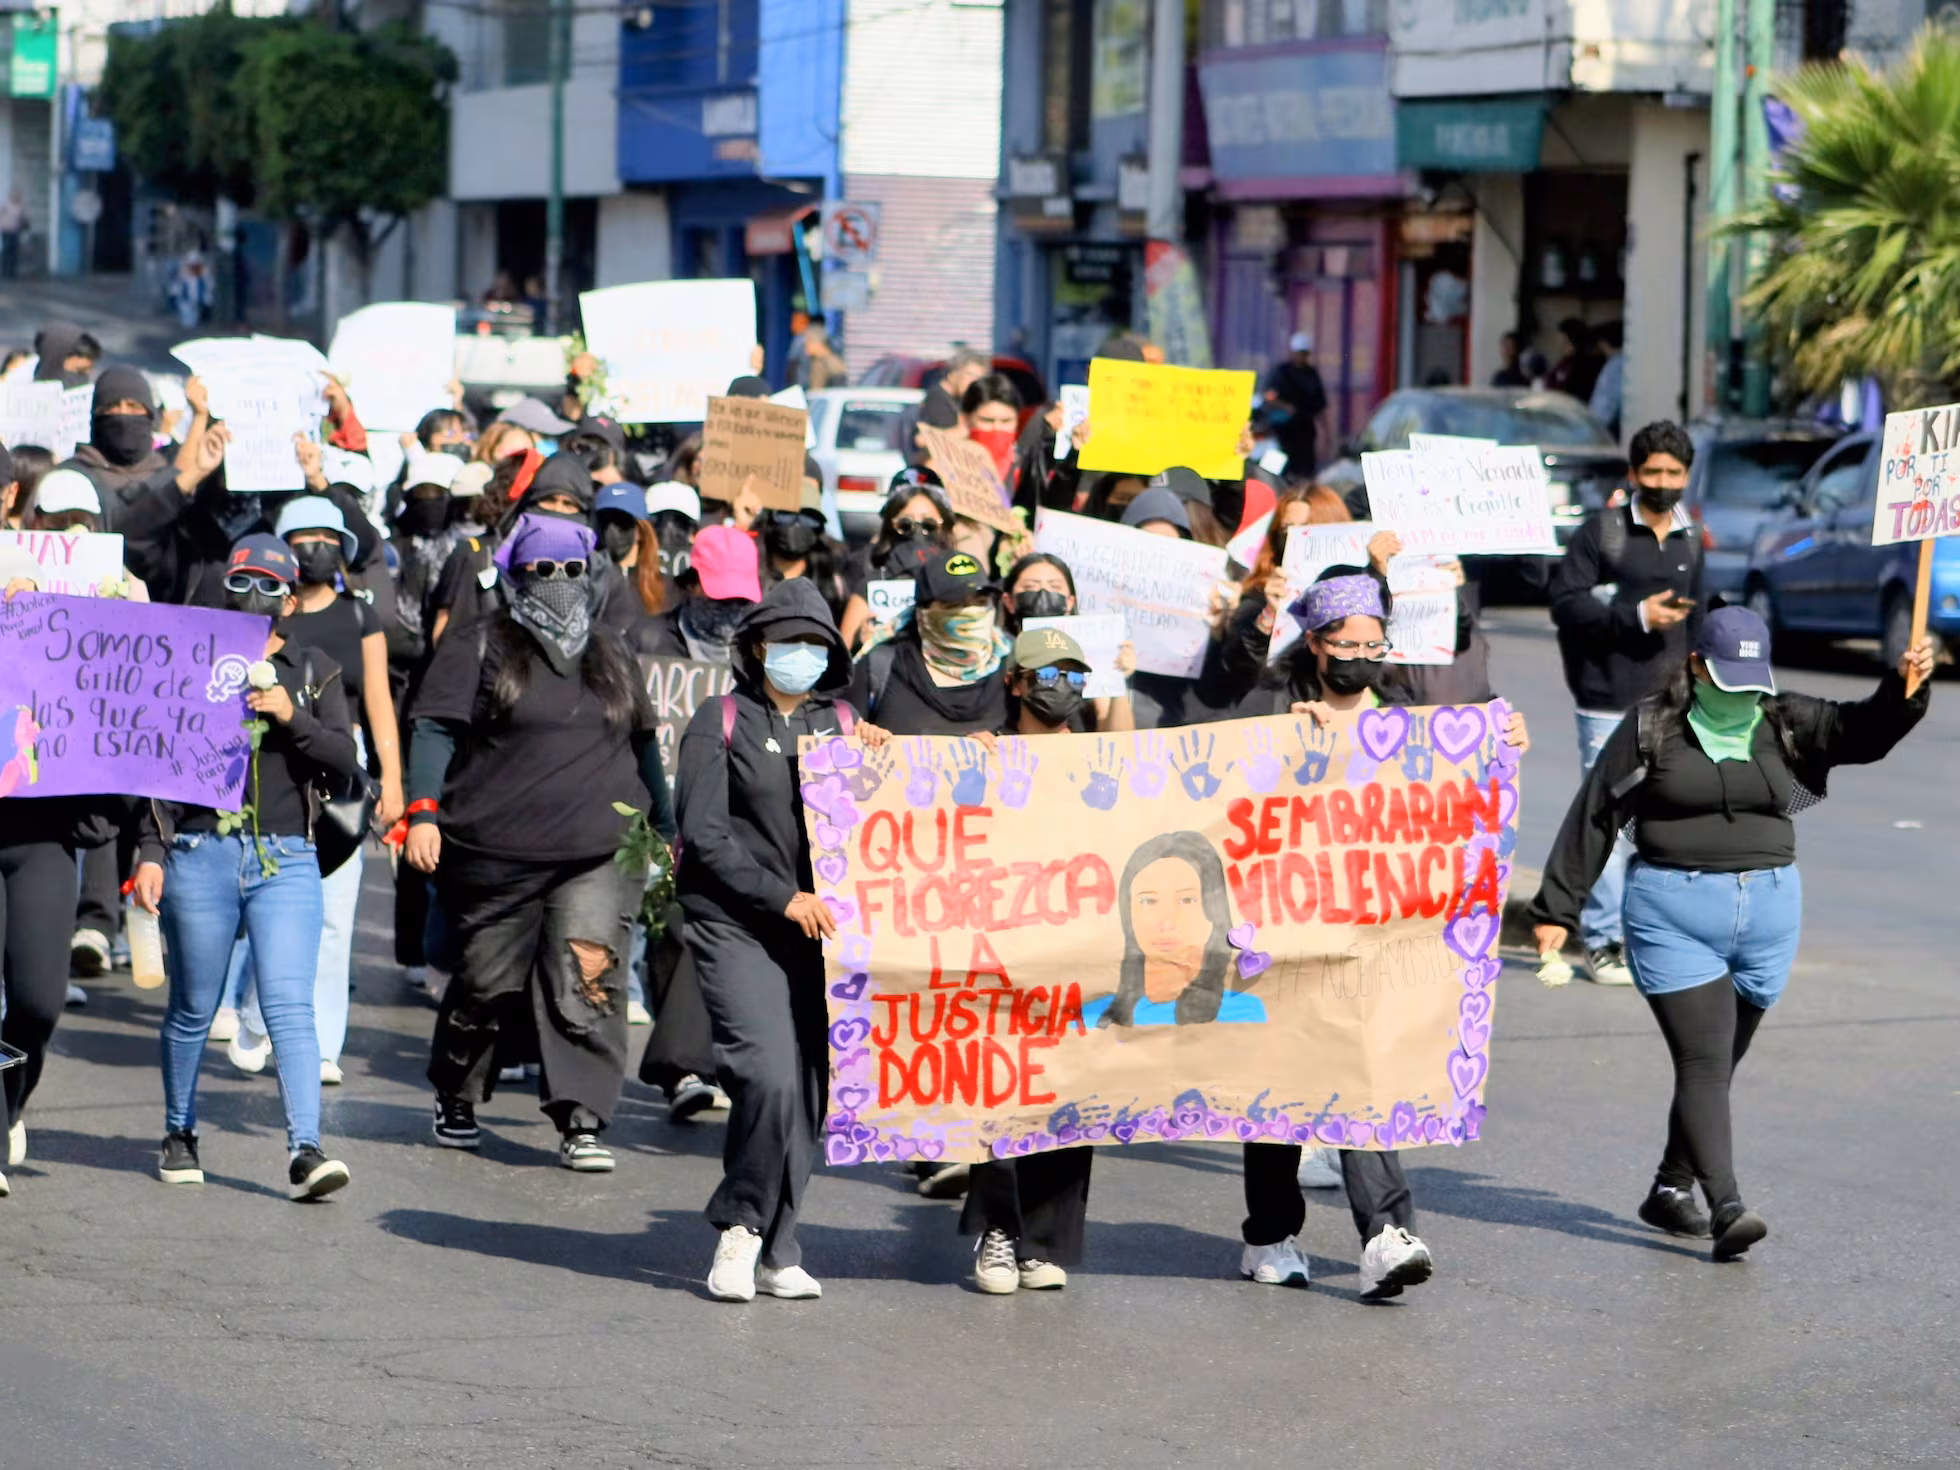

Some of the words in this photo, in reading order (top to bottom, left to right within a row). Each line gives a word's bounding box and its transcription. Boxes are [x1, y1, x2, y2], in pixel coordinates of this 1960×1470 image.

[1886, 454, 1917, 486] POR
[1930, 452, 1949, 473] TI
[1914, 475, 1942, 500] POR
[1887, 494, 1960, 540] TODAS
[45, 608, 173, 668] Somos
[192, 633, 216, 671] el
[153, 671, 196, 702] de
[859, 805, 995, 874] QUE
[1223, 775, 1501, 861] SEMBRARON
[855, 853, 1116, 938] FLOREZCA
[1226, 845, 1501, 929] VIOLENCIA
[928, 932, 1012, 990] LA
[870, 981, 1087, 1048] JUSTICIA
[877, 1035, 1060, 1109] DONDE
